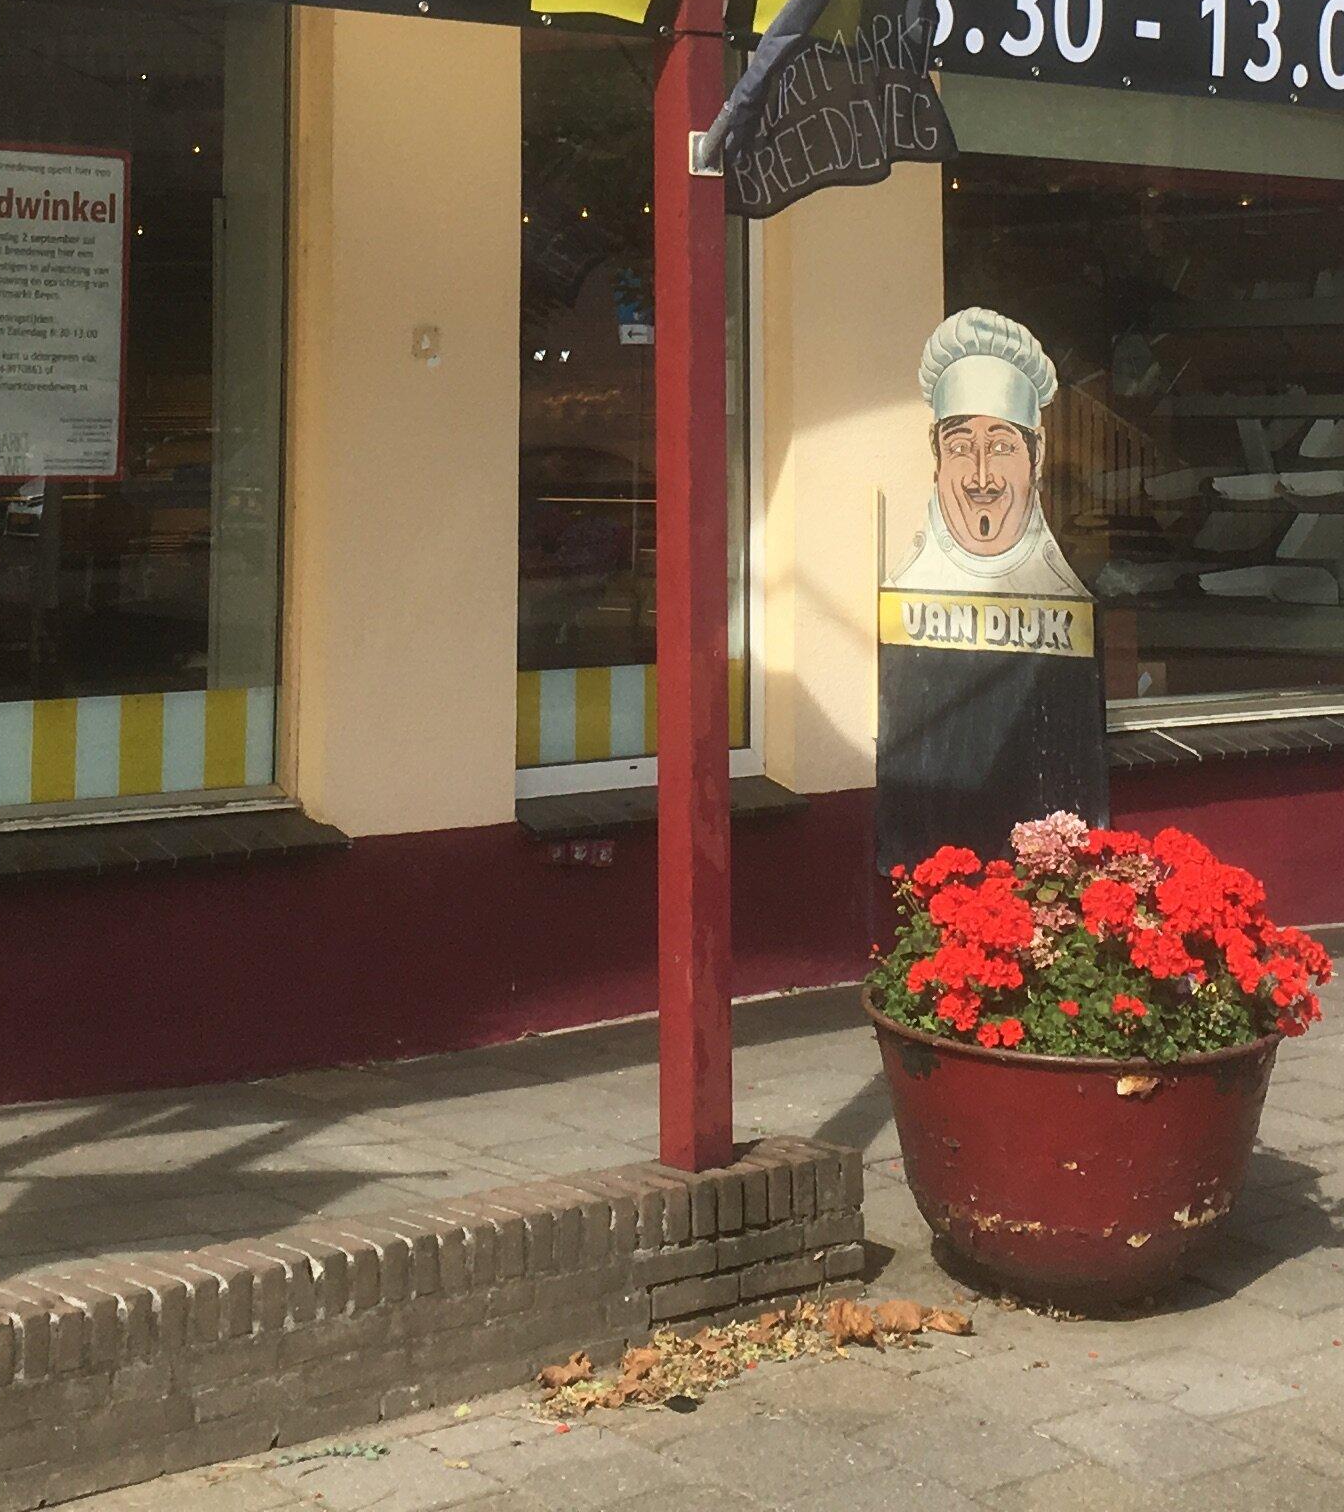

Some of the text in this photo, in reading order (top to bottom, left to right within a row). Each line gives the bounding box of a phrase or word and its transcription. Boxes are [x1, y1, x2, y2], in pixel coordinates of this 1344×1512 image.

[756, 14, 933, 138] URTMARKT
[901, 601, 1074, 651] VAN DIJK
